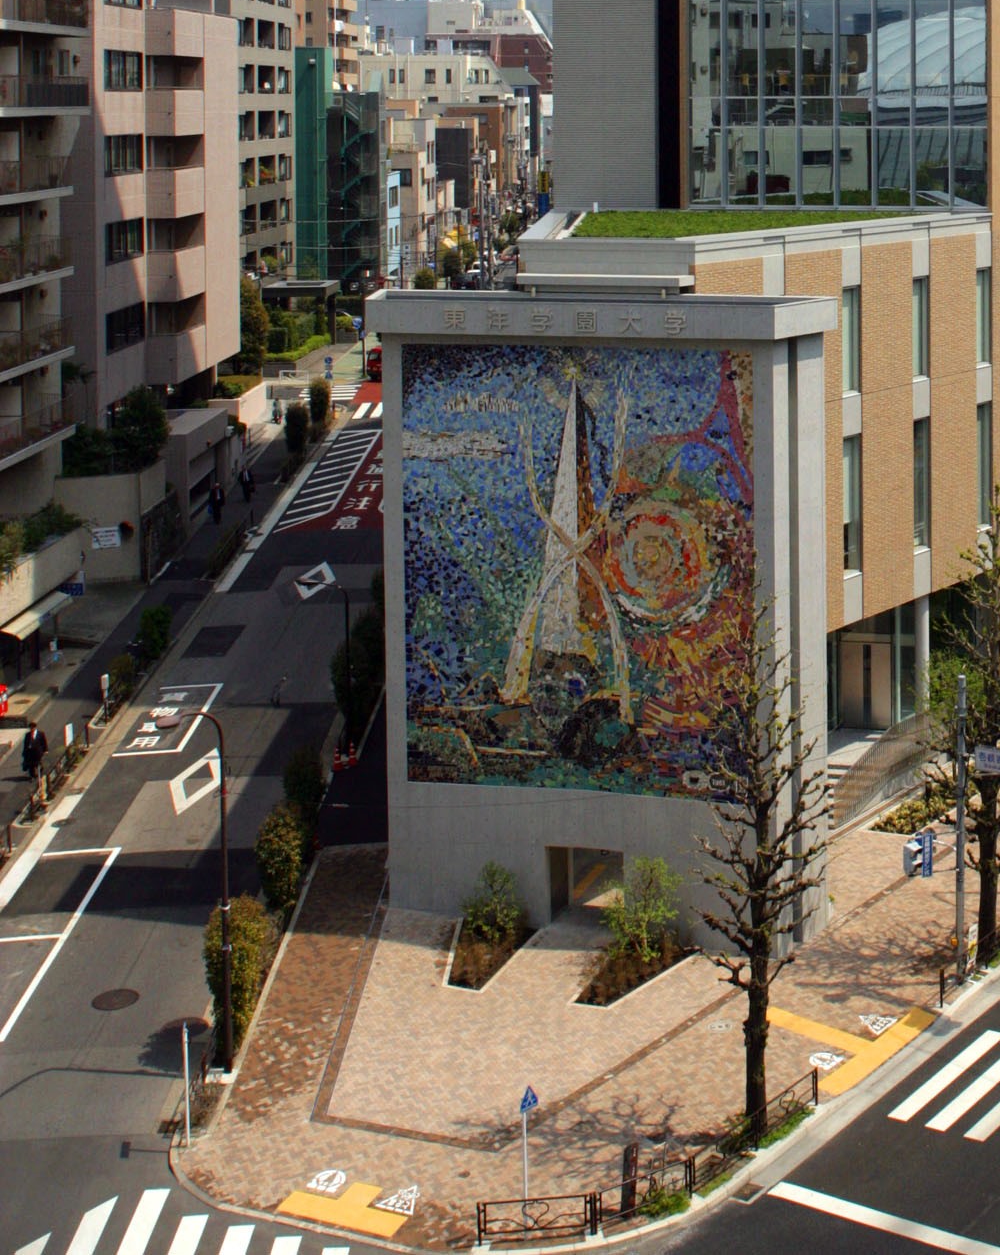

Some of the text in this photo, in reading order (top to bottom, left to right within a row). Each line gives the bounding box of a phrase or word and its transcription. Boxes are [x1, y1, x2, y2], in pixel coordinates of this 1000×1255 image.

[444, 308, 687, 334] 東洋学園大学
